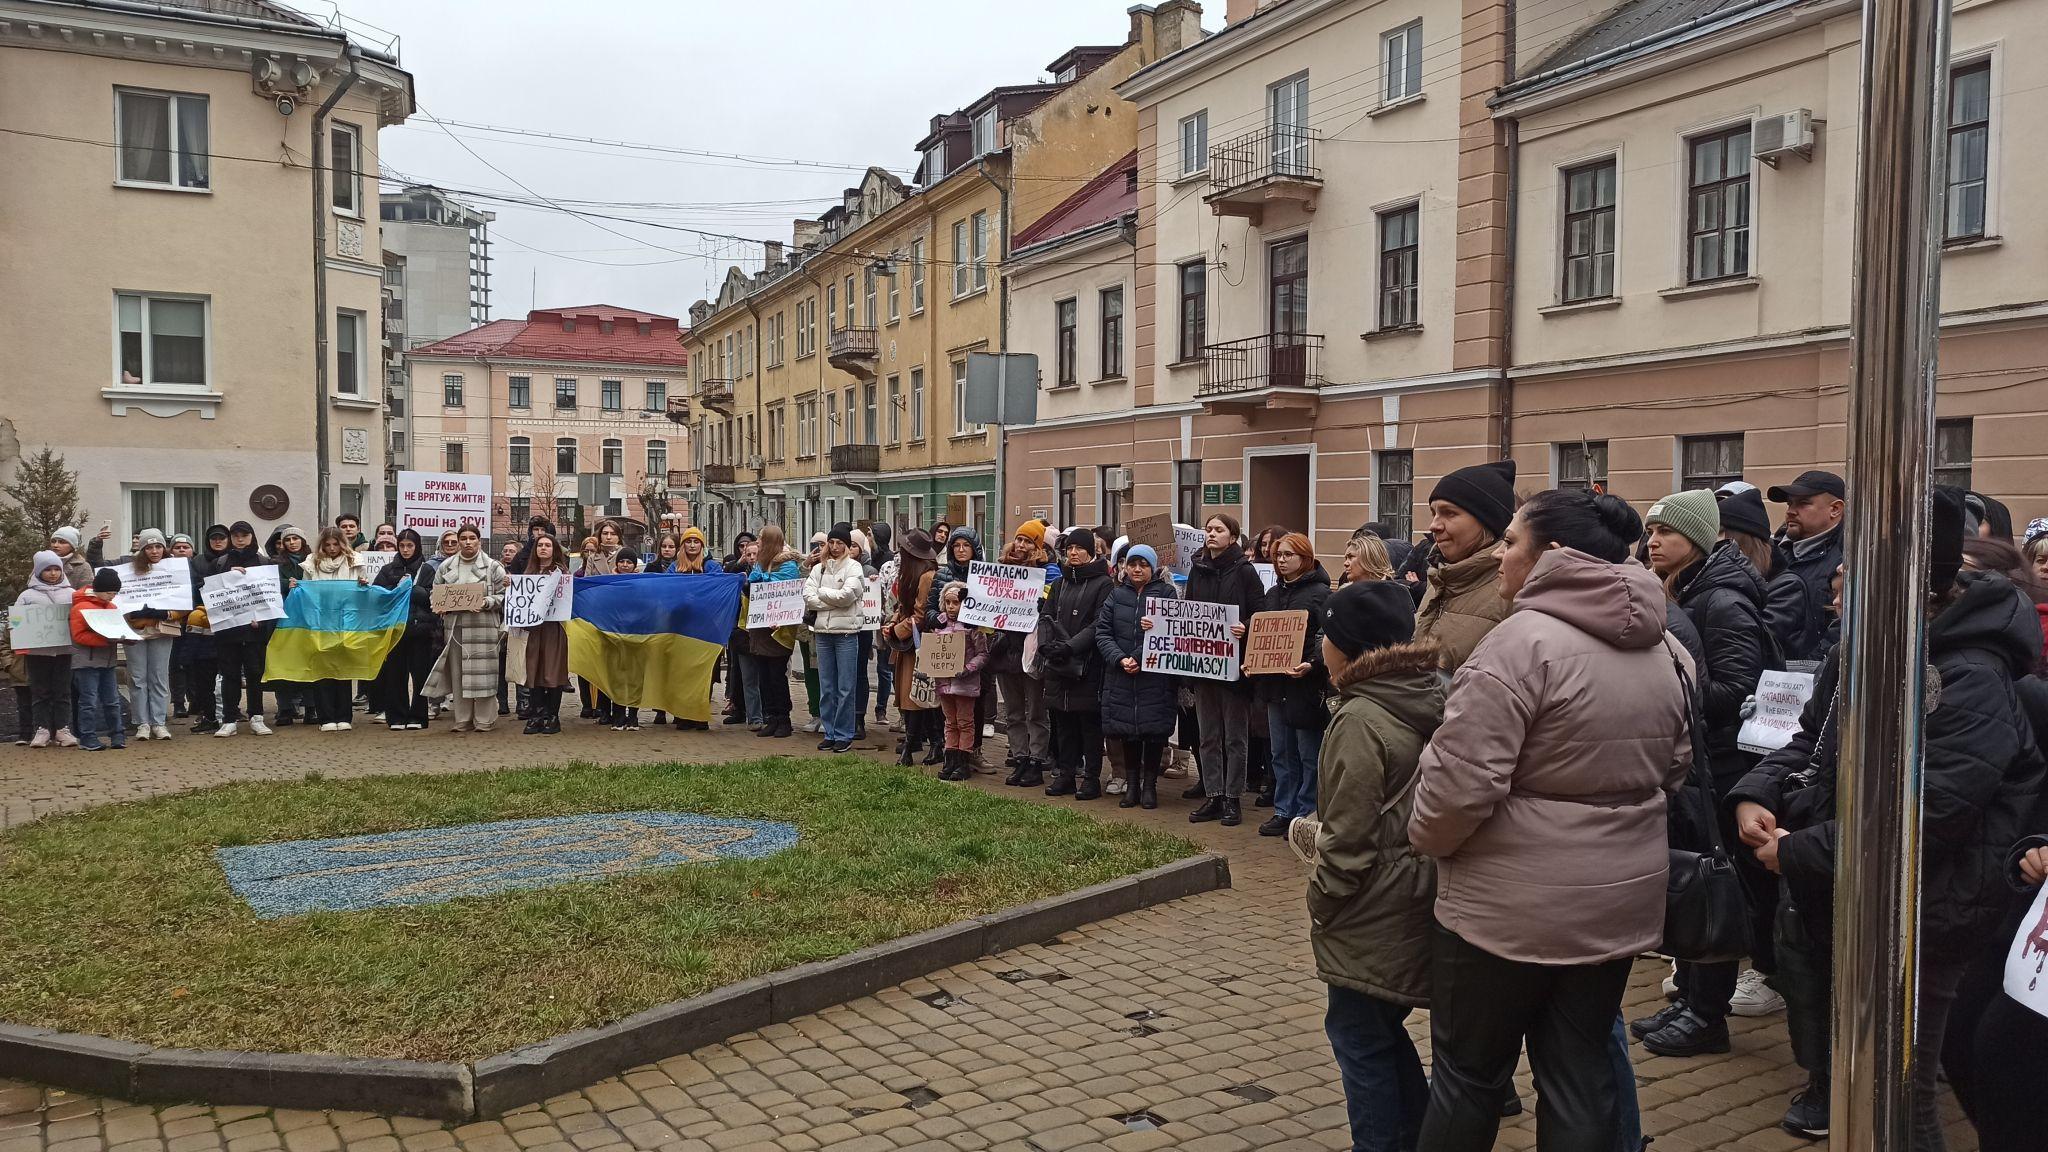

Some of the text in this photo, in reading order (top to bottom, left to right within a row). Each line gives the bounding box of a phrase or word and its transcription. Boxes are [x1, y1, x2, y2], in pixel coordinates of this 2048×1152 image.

[425, 480, 467, 491] БРУКІВКА
[405, 491, 486, 503] НЕ ВРЯТУЄ ЖИТТЯ!
[404, 514, 438, 528] Гроші
[442, 518, 456, 527] на
[367, 556, 385, 564] НАМ
[971, 563, 1029, 580] ВИМАГАЄМО
[510, 576, 545, 596] МОЄ
[755, 580, 805, 593] ЗА ПЕРЕМОГУ
[978, 575, 1015, 588] ТЕРМІНІВ
[209, 592, 215, 600] Я
[241, 583, 256, 591] щоб
[767, 600, 782, 611] ВСІ
[25, 605, 68, 624] ГРОШ
[748, 613, 765, 624] ПОРА
[993, 613, 1008, 629] 18
[1252, 616, 1304, 633] ВИТЯГНІТЬ
[936, 633, 953, 644] ЗСУ
[1253, 634, 1294, 650] СОВІСТЬ
[941, 644, 947, 652] В
[930, 652, 957, 660] ПЕРШУ
[1247, 652, 1293, 669] ЗІ СРАКИ
[931, 662, 955, 671] ЧЕРГУ
[1791, 683, 1806, 692] ХАТУ
[1760, 691, 1800, 706] НАПАДАЮТЬ
